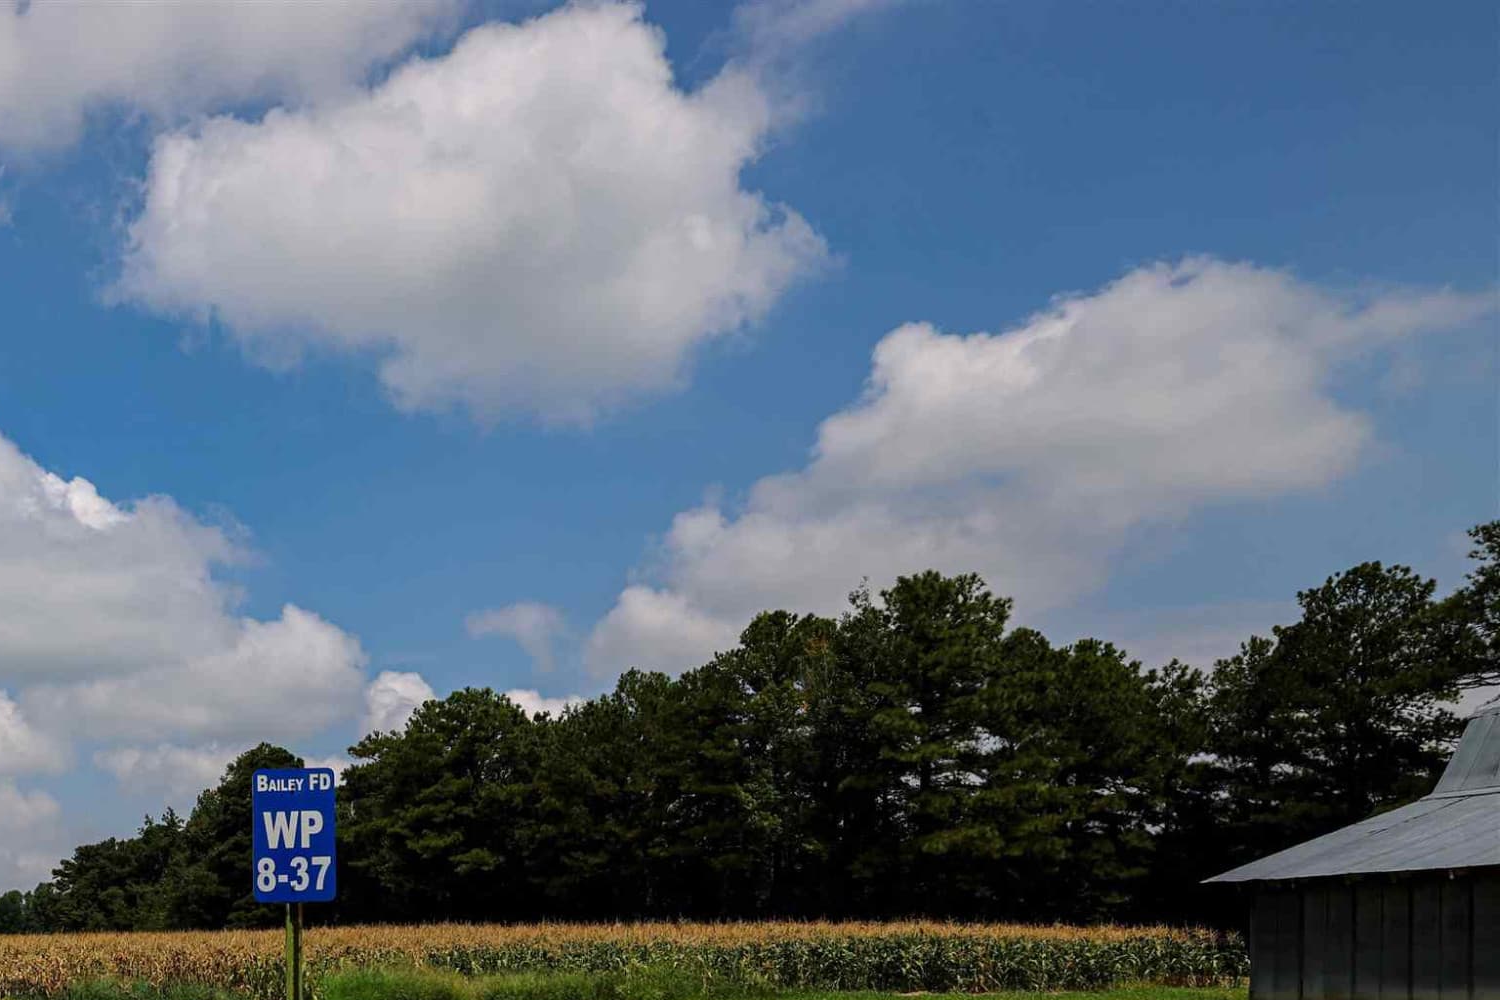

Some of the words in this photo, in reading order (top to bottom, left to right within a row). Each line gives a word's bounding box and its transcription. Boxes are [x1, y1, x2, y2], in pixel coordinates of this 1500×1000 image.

[309, 774, 330, 791] FD
[263, 810, 324, 849] WP
[257, 856, 332, 892] 8-37
